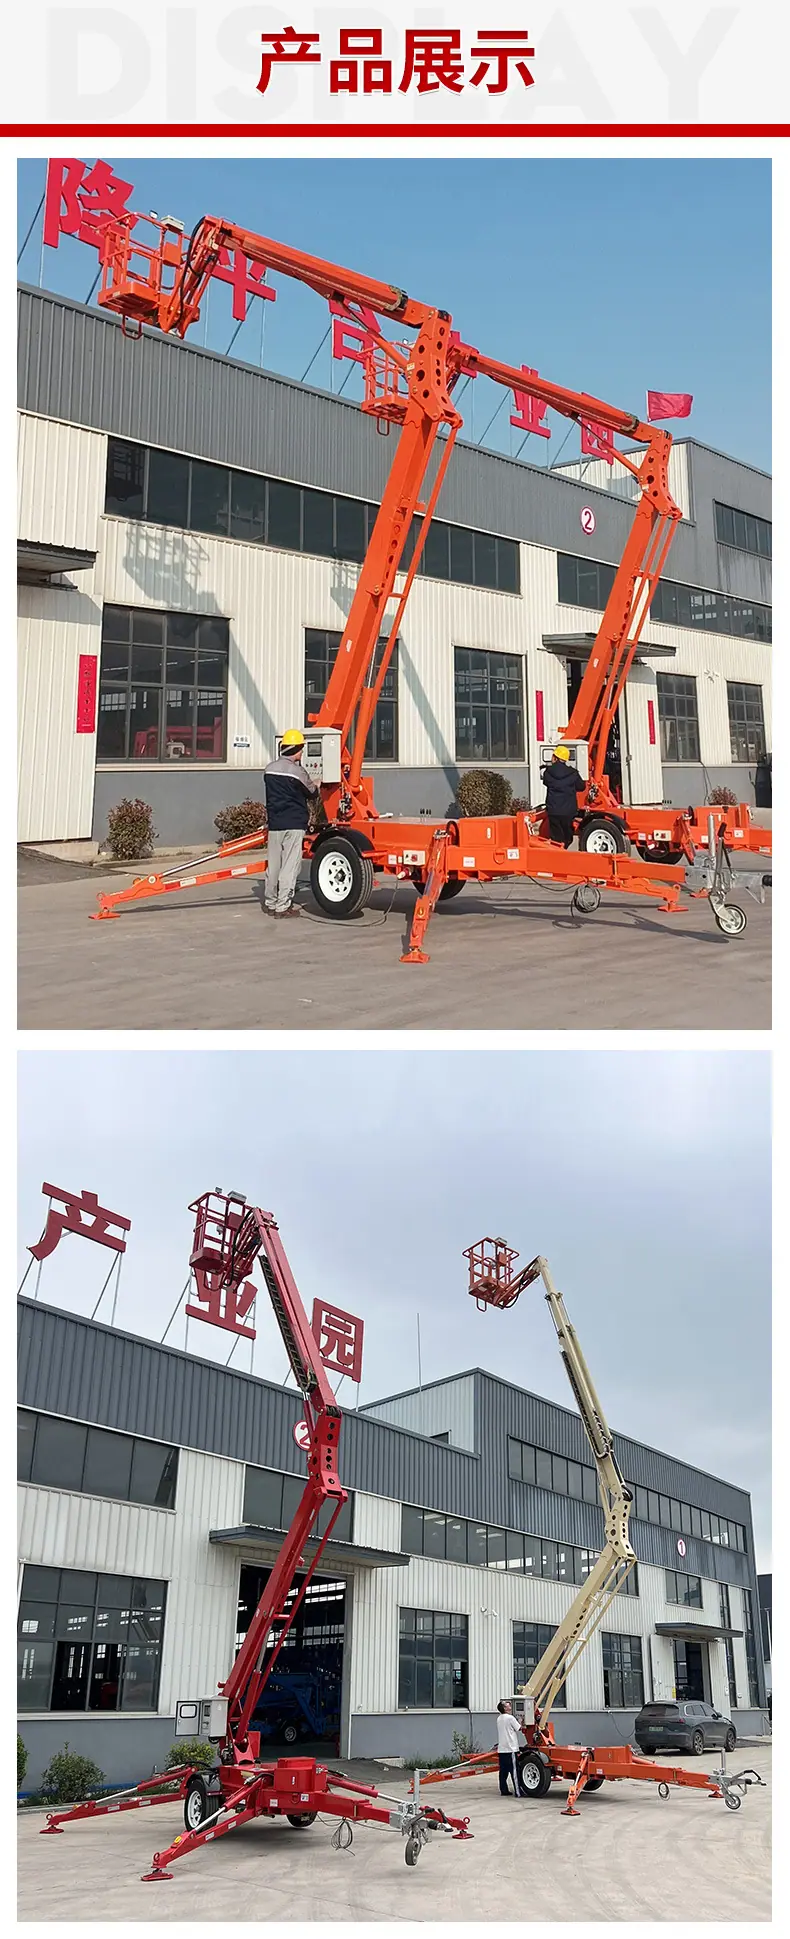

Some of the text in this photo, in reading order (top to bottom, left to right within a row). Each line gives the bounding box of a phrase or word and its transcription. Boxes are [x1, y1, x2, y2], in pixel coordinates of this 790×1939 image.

[583, 509, 593, 532] 2
[28, 1182, 364, 1383] 产业园
